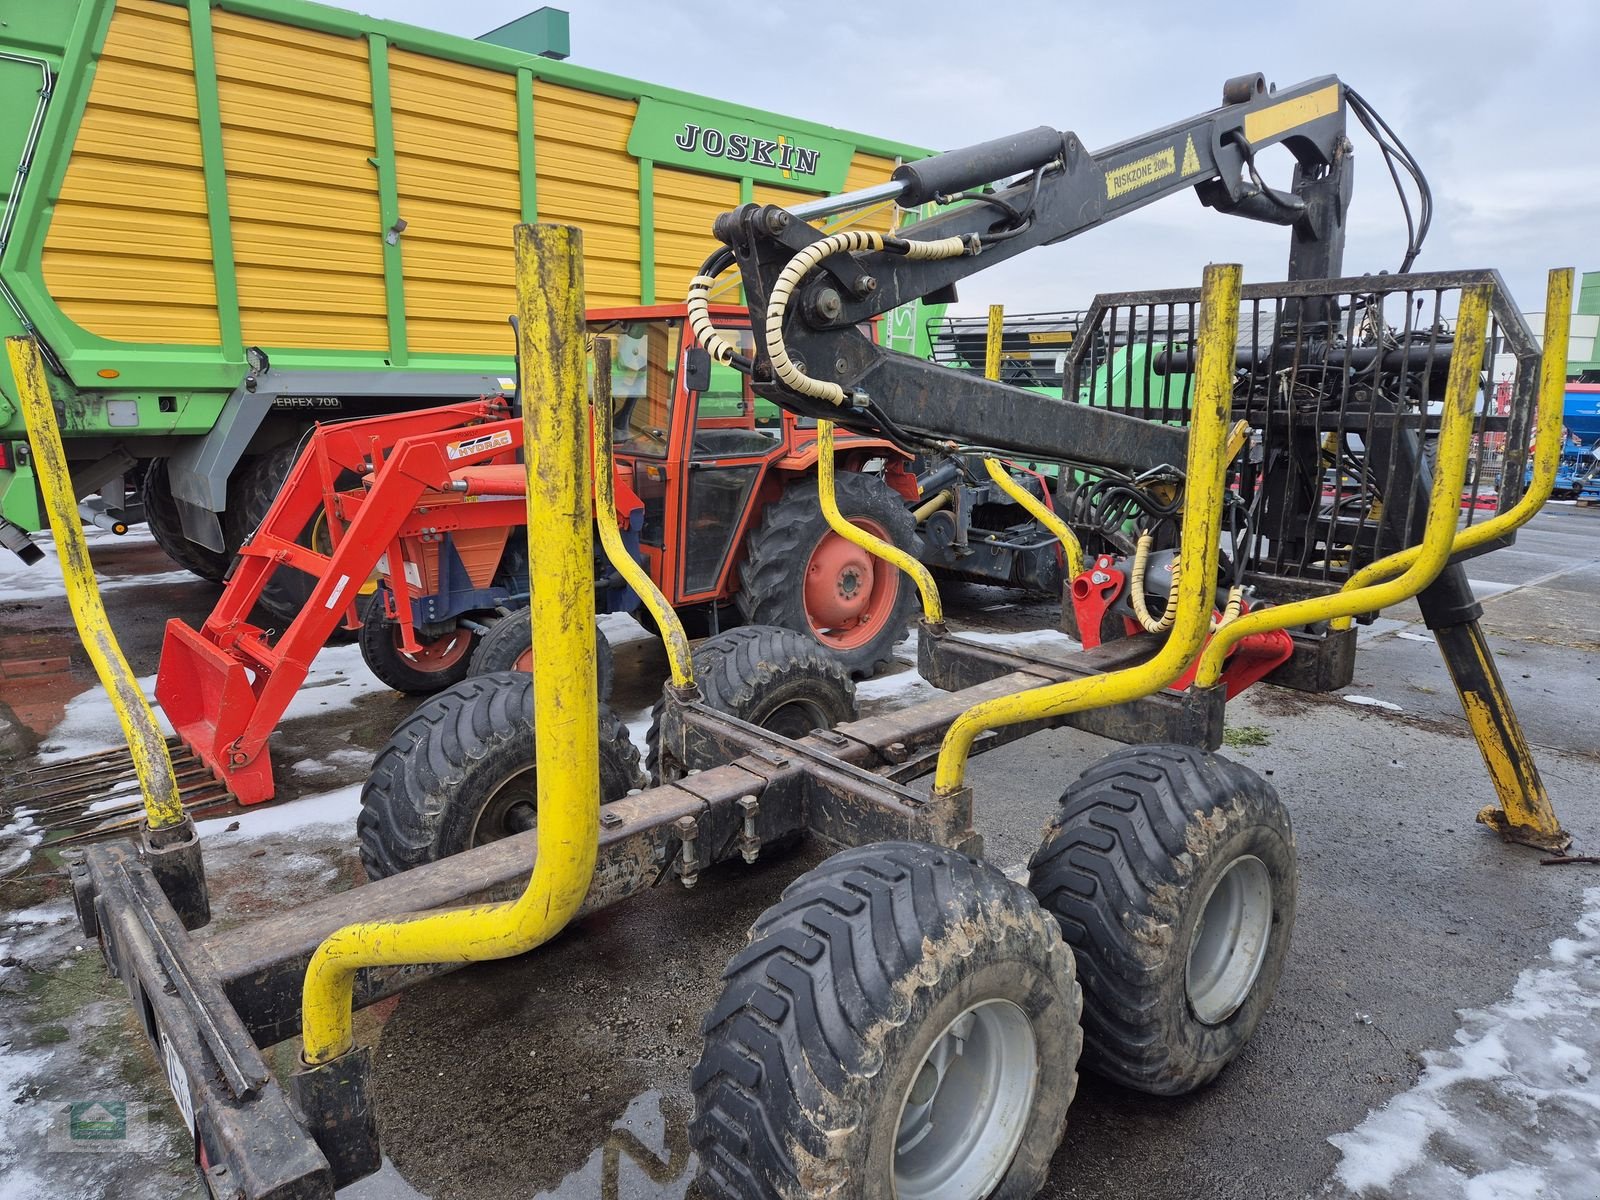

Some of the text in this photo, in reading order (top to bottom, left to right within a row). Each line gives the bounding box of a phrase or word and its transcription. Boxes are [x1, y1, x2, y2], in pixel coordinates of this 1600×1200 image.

[675, 123, 820, 175] JOSKIN
[1113, 163, 1153, 189] RISKZONE
[316, 397, 339, 407] 700
[458, 436, 509, 456] HYDRAC
